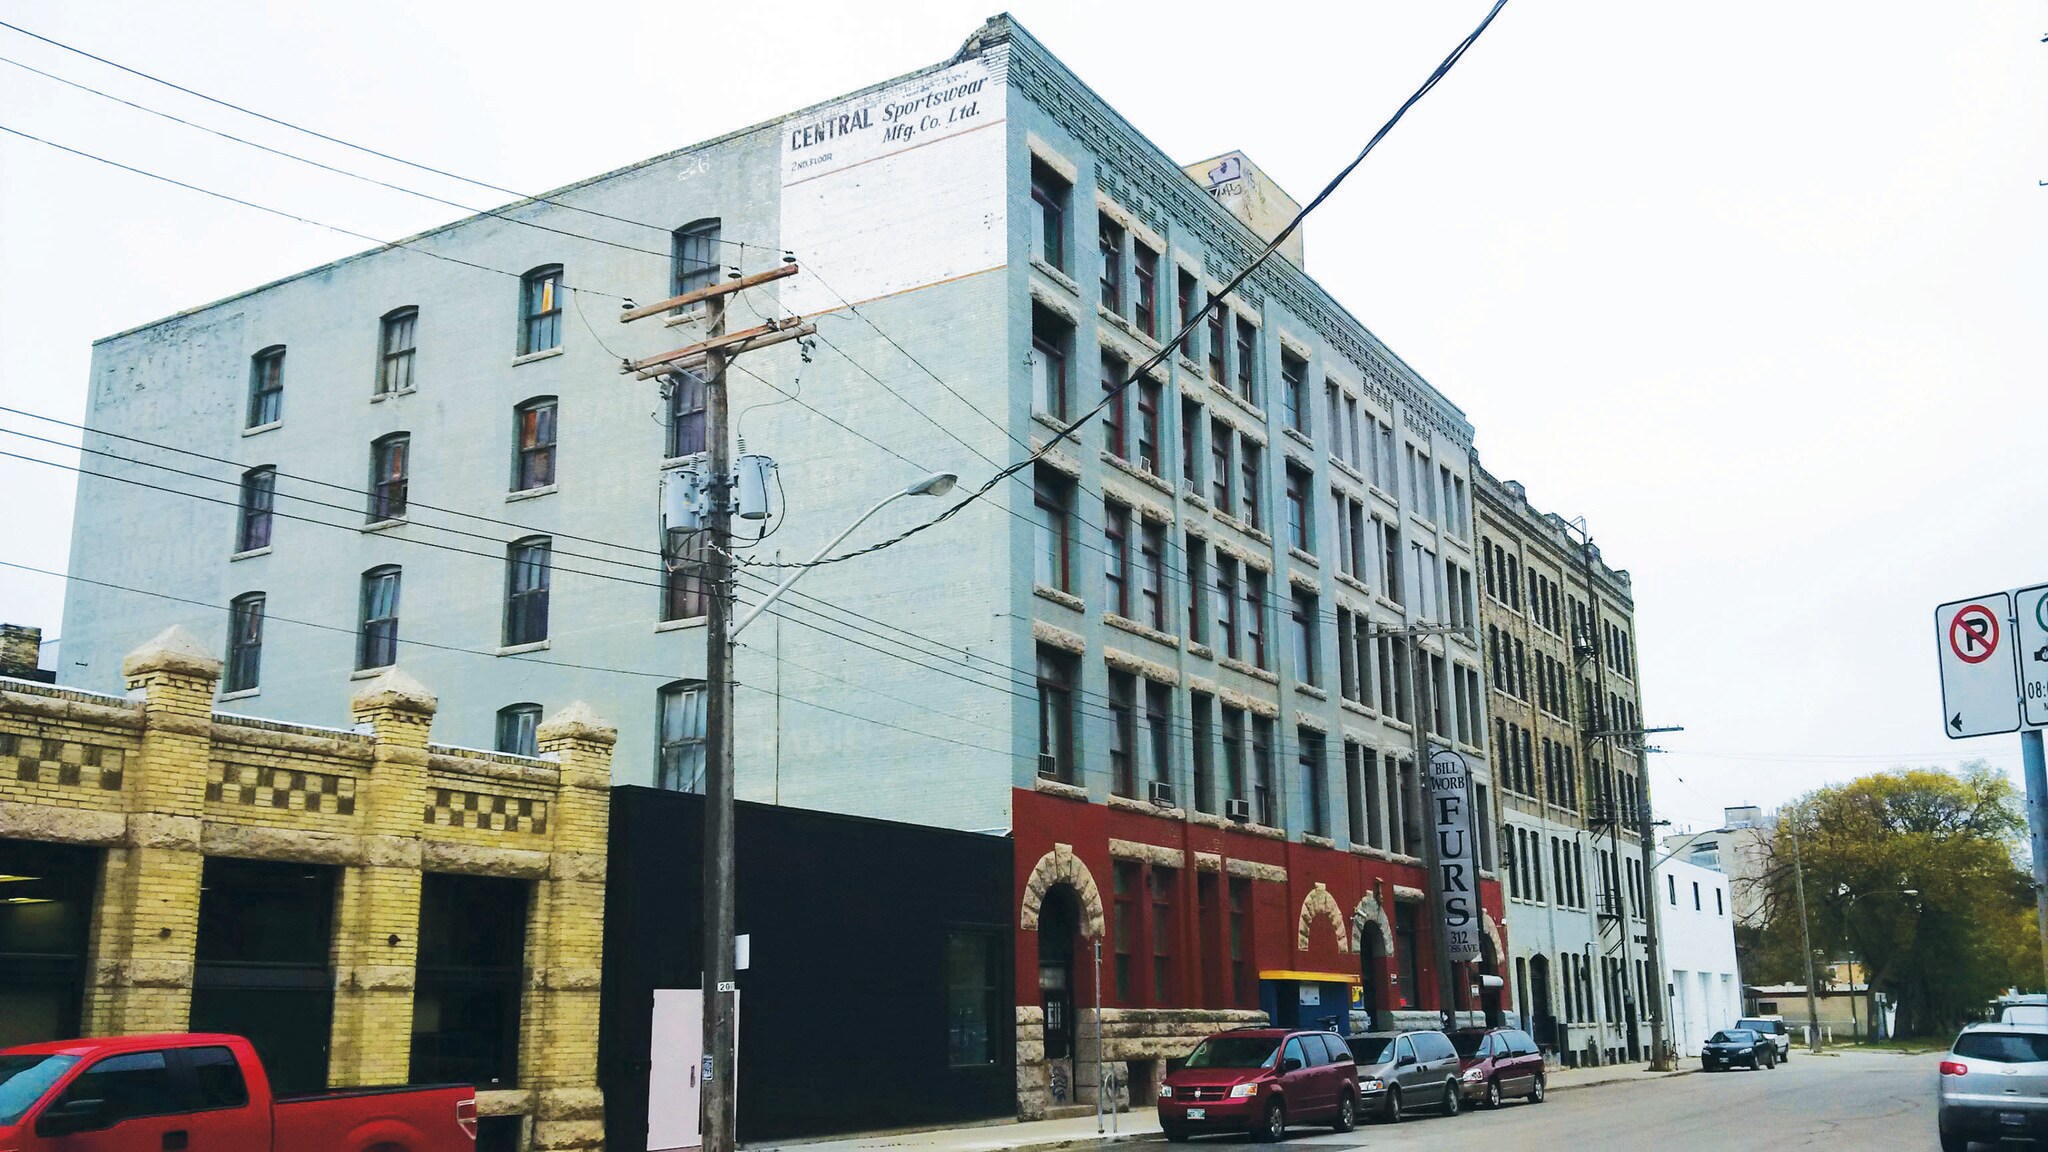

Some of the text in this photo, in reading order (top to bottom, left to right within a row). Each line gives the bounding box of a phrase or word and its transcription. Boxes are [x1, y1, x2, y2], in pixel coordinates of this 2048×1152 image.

[792, 76, 989, 151] CENTRAL Sportswear
[882, 101, 980, 143] Mfg. Co. Ltd.
[2028, 681, 2048, 699] 08:
[1435, 762, 1458, 775] BILL
[1431, 776, 1465, 791] WORB
[1436, 797, 1470, 927] FURS
[1451, 931, 1468, 944] 312
